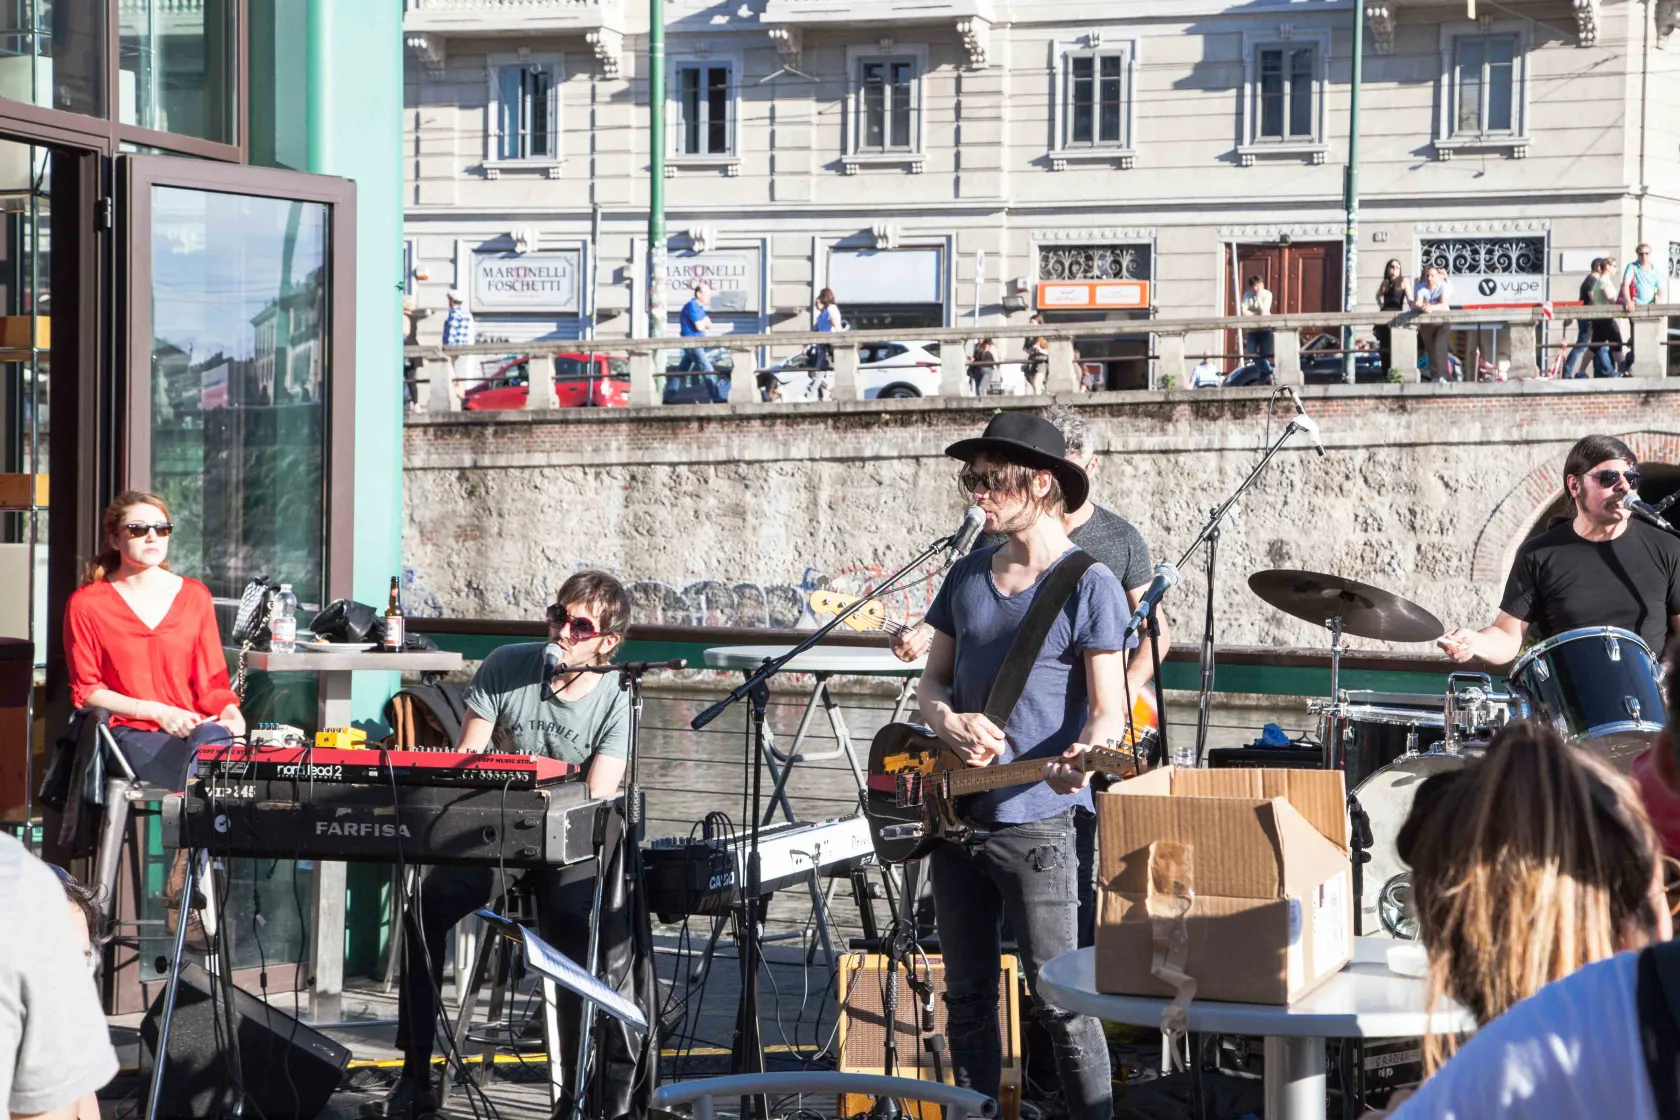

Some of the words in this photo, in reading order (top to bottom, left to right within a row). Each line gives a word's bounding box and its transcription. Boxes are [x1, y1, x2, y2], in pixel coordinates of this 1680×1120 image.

[482, 266, 567, 278] MARTINELLI
[487, 280, 561, 292] FOSCHETTI
[1501, 280, 1540, 295] vype
[276, 764, 306, 776] nord
[306, 764, 333, 776] lead
[334, 765, 343, 777] 2
[315, 821, 412, 838] FARFISA
